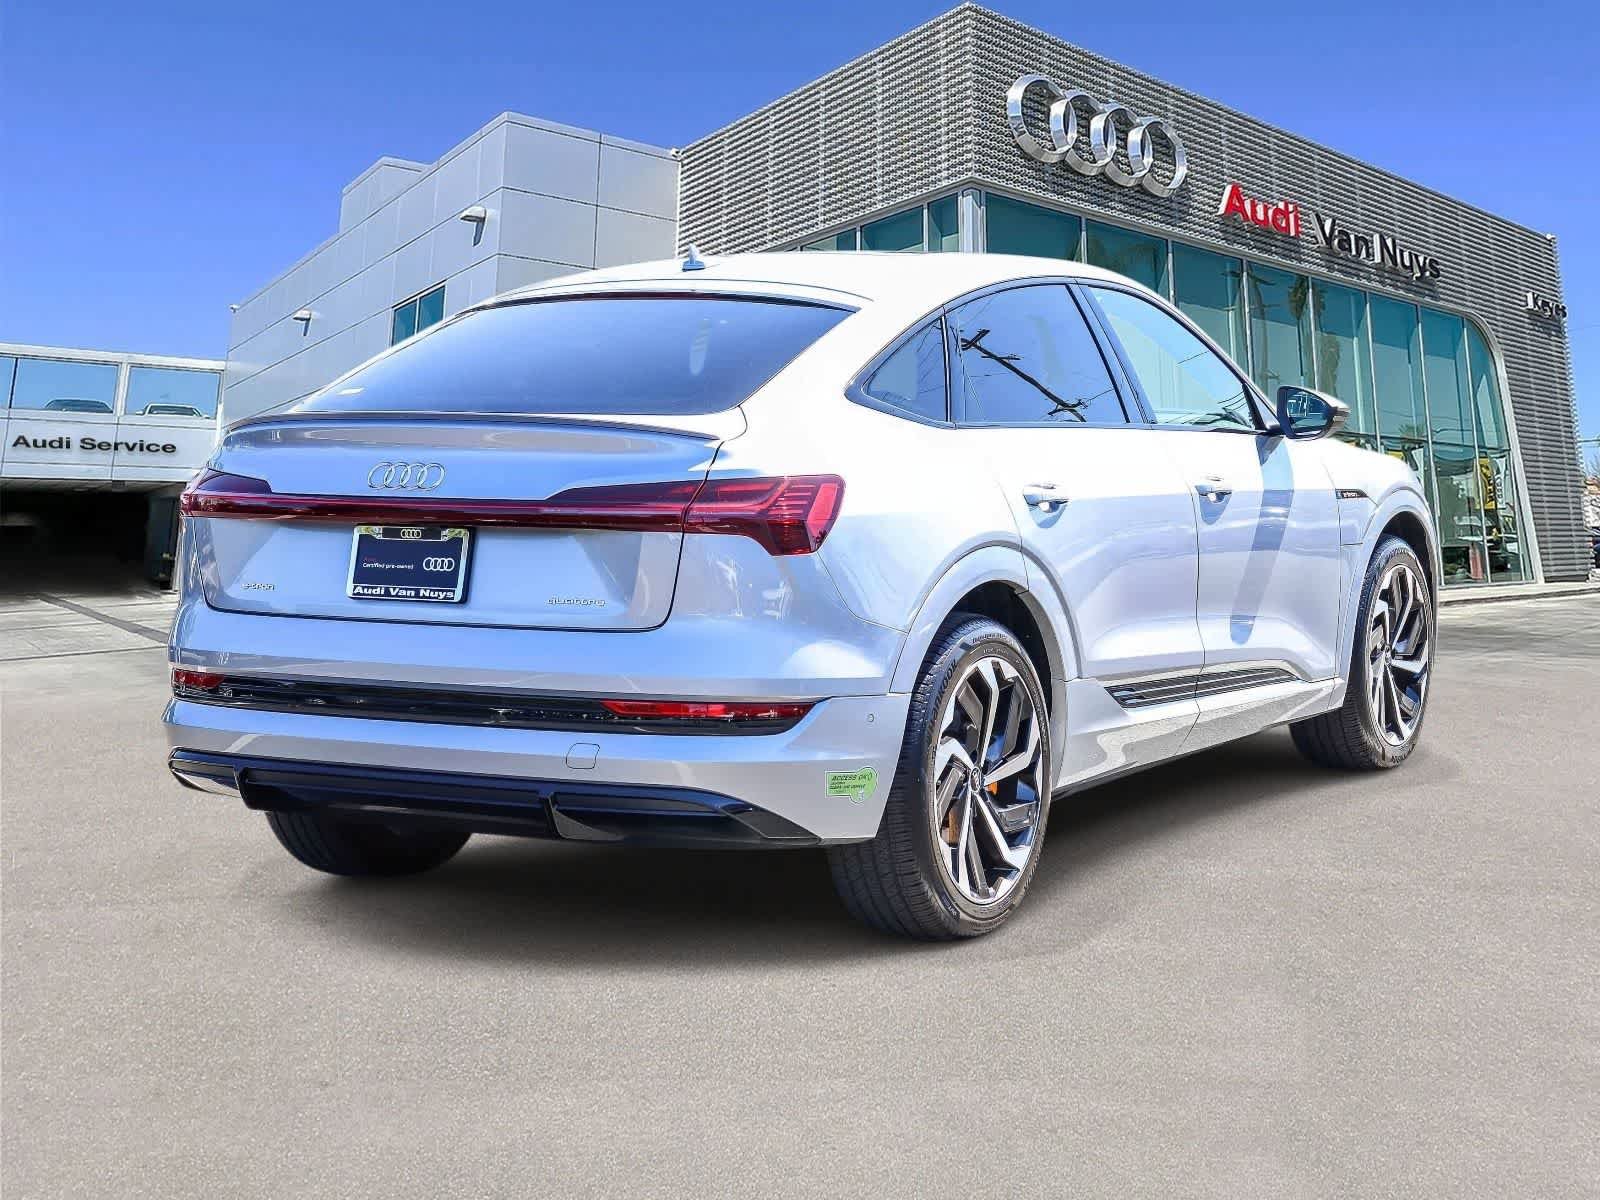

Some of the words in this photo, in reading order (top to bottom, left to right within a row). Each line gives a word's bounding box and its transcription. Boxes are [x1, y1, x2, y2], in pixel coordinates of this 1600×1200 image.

[1219, 183, 1301, 238] Audi
[1311, 213, 1373, 260] Van
[1373, 233, 1440, 280] Nuys
[12, 435, 71, 449] Audi
[79, 437, 177, 453] Service
[353, 586, 385, 596] Audi
[389, 587, 415, 597] Van
[419, 589, 454, 599] Nuys
